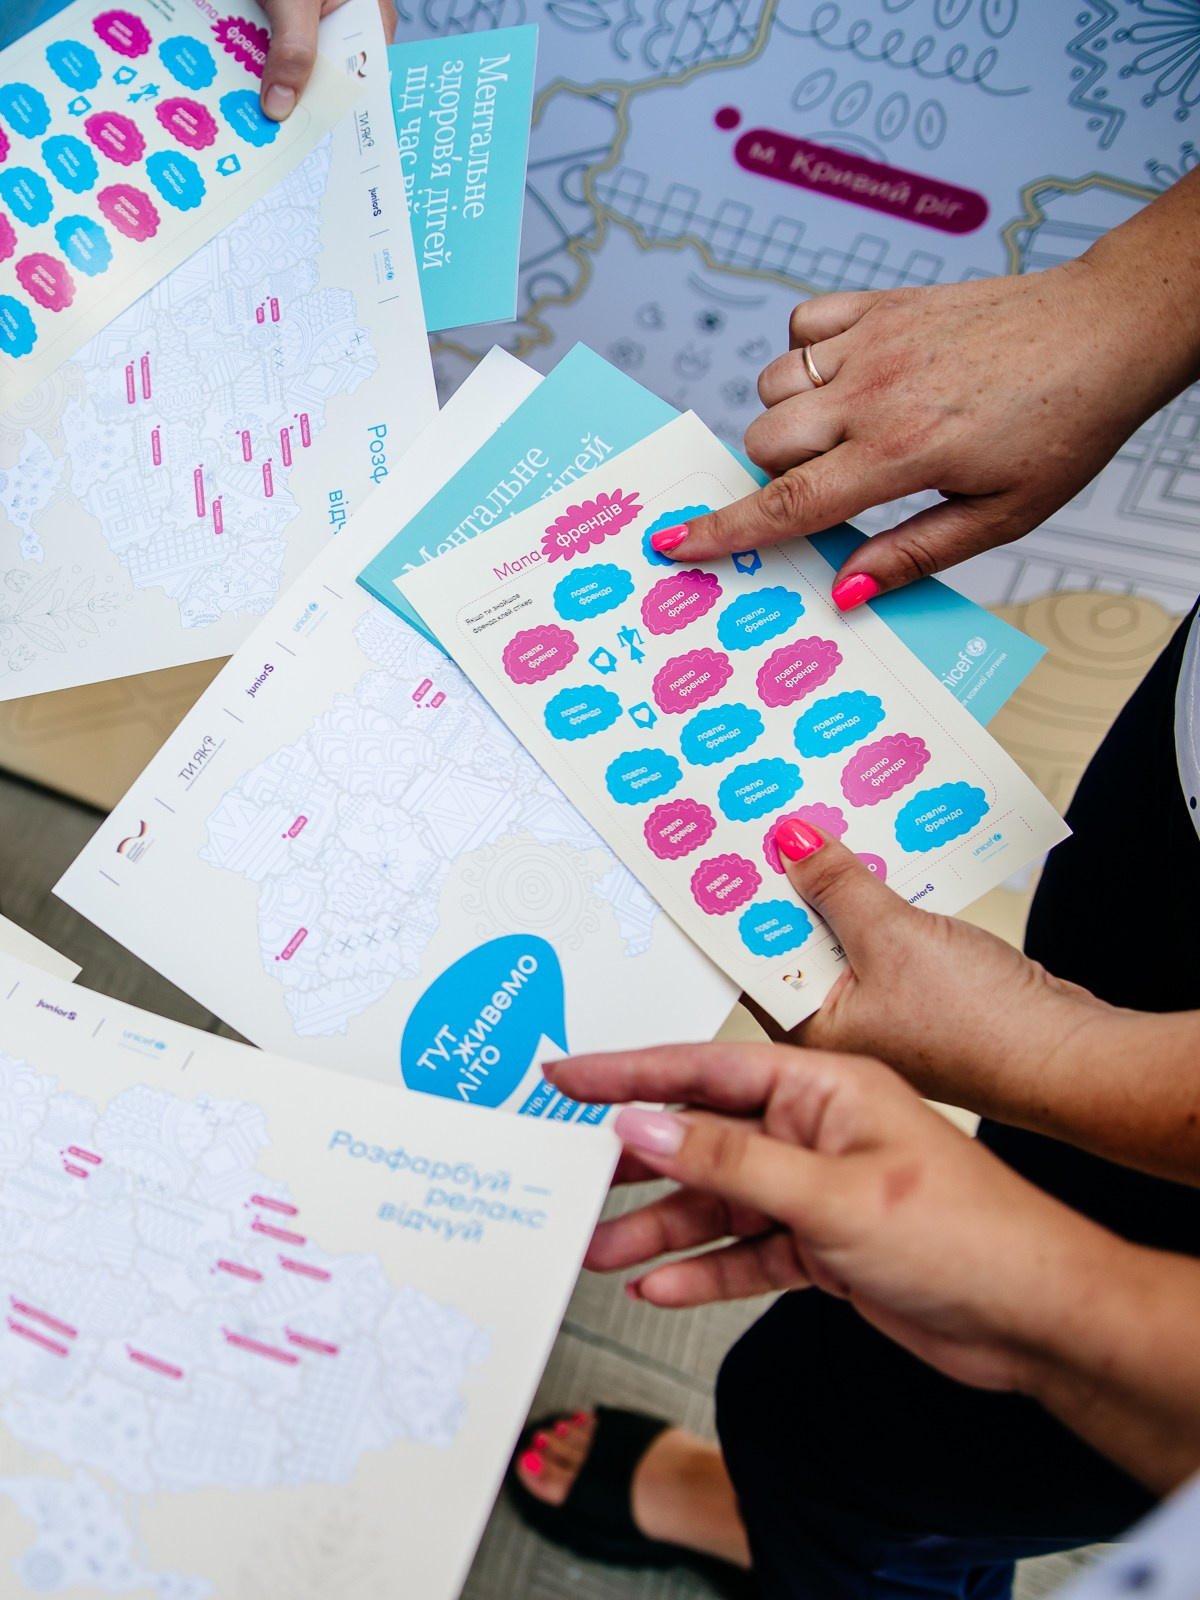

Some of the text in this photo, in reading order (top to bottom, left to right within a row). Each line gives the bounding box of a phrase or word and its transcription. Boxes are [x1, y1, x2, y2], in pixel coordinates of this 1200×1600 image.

[397, 65, 436, 112] під
[358, 110, 368, 124] ТИ
[399, 116, 421, 165] час
[463, 53, 511, 219] Ментальне
[422, 60, 465, 271] здоров'я дітей
[790, 148, 911, 207] Кривий
[913, 190, 966, 224] ріг
[367, 187, 382, 217] juniorS
[382, 247, 393, 272] unicef
[367, 423, 389, 484] Розф
[492, 501, 623, 581] Мапа френдів
[570, 582, 599, 599] ловлю
[578, 586, 612, 606] френда
[658, 590, 685, 613] ловлю
[667, 592, 700, 618] френда
[735, 607, 766, 627] ловлю
[292, 608, 312, 633] unicef
[744, 610, 781, 634] френда
[518, 644, 544, 663] ловлю
[528, 647, 558, 669] френда
[246, 663, 274, 698] juniorS
[669, 669, 696, 692] ловлю
[679, 671, 711, 697] френда
[774, 660, 803, 684] ловлю
[784, 660, 819, 689] френда
[940, 651, 968, 693] nicef
[697, 724, 726, 742] ловлю
[812, 712, 845, 733] ловлю
[822, 715, 861, 740] френда
[705, 728, 741, 749] френда
[178, 762, 198, 782] ТИ
[859, 757, 890, 782] ловлю
[871, 758, 906, 787] френда
[734, 779, 764, 798] ловлю
[743, 783, 779, 805] френда
[914, 804, 947, 826] ловлю
[924, 808, 964, 833] френда
[659, 818, 684, 838] ловлю
[668, 822, 698, 845] френда
[973, 840, 994, 857] unicef
[706, 873, 730, 893] ловлю
[715, 877, 743, 899] френда
[907, 884, 934, 904] uniorS
[328, 1129, 513, 1193] Розфарбуй
[424, 1186, 548, 1230] релакс
[377, 1201, 484, 1243] відчуй
